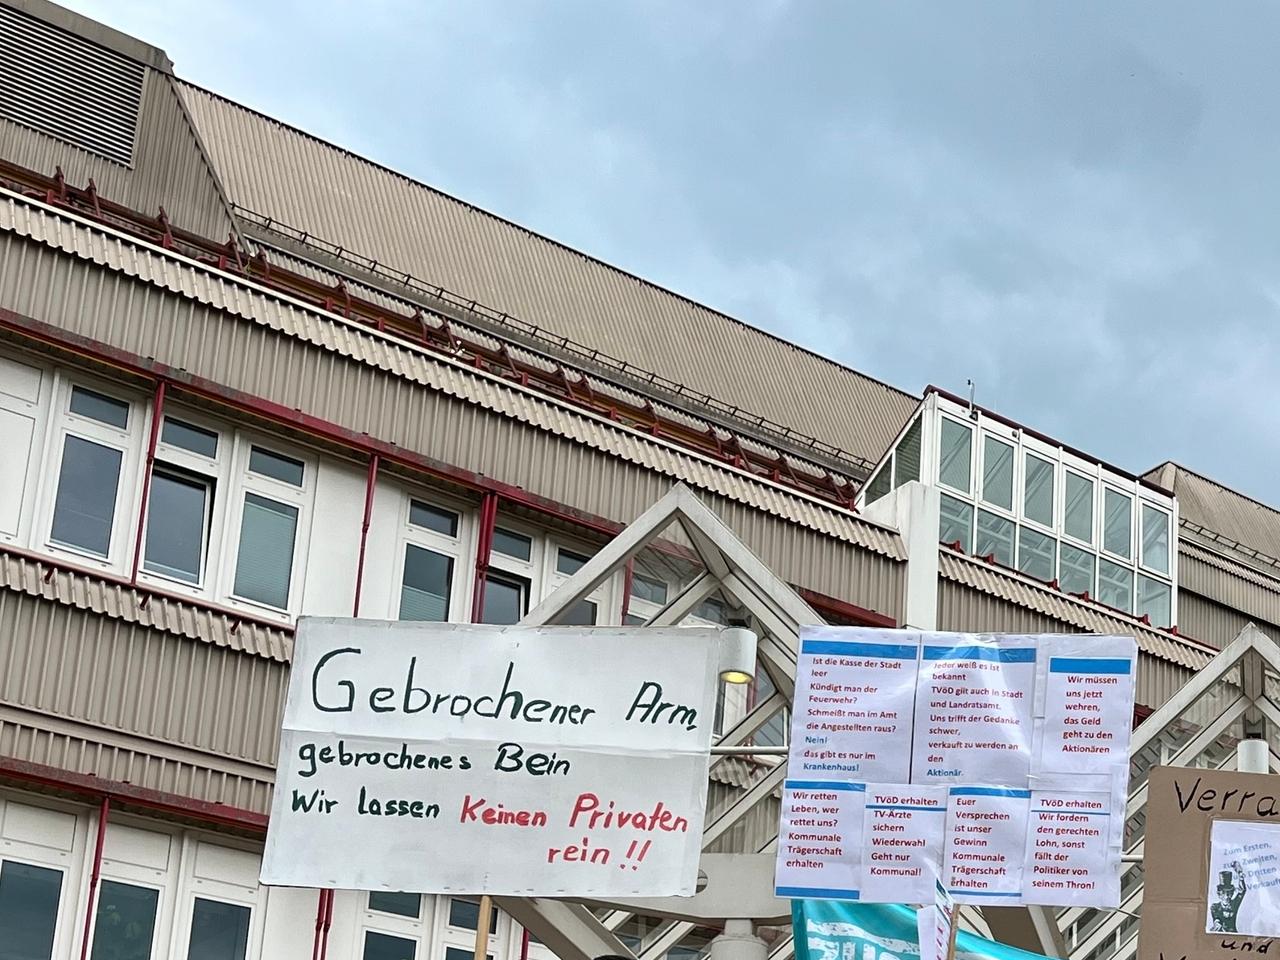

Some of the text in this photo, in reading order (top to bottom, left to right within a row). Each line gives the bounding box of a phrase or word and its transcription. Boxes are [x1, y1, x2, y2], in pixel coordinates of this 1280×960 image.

[880, 661, 901, 669] Stadt
[1085, 676, 1117, 684] müssen
[312, 648, 595, 726] Gebrochener
[810, 683, 842, 693] Kündigt
[864, 685, 877, 693] der
[931, 686, 1023, 699] TVöD gilt auch Stadt
[1083, 690, 1102, 699] jetzt
[809, 695, 857, 703] Feuerwehr?
[1066, 703, 1100, 712] wehren,
[808, 709, 845, 717] Schmeißt
[880, 711, 897, 719] Amt
[948, 714, 966, 722] trifft
[984, 715, 1020, 725] Gedanke
[821, 723, 872, 732] Angestellten
[874, 725, 896, 733] raus?
[929, 727, 960, 735] schwer,
[1063, 731, 1082, 739] geht
[1096, 731, 1112, 739] den
[805, 736, 827, 744] Nein!
[928, 741, 963, 749] verkauft
[975, 741, 1006, 749] werden
[1062, 745, 1109, 753] Aktionären
[298, 741, 570, 777] gebrochenes Bein
[804, 750, 818, 758] das
[820, 751, 836, 759] gibt
[865, 752, 875, 760] im
[803, 763, 859, 771] Krankenhaus!
[875, 796, 938, 806] TVöD erhalten
[956, 798, 976, 806] Euer
[1065, 800, 1101, 809] erhalten
[291, 786, 688, 833] Wir lassen Keinen Privaten
[791, 805, 820, 814] Leben,
[874, 808, 912, 819] TV-Ärzte
[956, 811, 1010, 820] Versprechen
[1056, 813, 1089, 822] fordern
[817, 819, 837, 827] uns?
[873, 824, 904, 832] sichern
[1055, 827, 1099, 836] gerechten
[789, 832, 841, 842] Kommunale
[872, 838, 926, 847] Wiederwahl
[954, 838, 987, 846] Gewinn
[1036, 839, 1059, 848] Lohn,
[547, 838, 610, 866] rein
[788, 846, 842, 856] Trägerschaft
[871, 853, 892, 861] Geht
[953, 853, 1005, 862] Kommunale
[1035, 852, 1069, 861] fällt der
[787, 859, 823, 868] erhalten
[871, 867, 922, 876] Kommunal!
[952, 866, 1006, 875] Trägerschaft
[1034, 866, 1070, 875] Politiker
[1032, 880, 1095, 889] seinem Thron!
[1220, 939, 1272, 954] und
